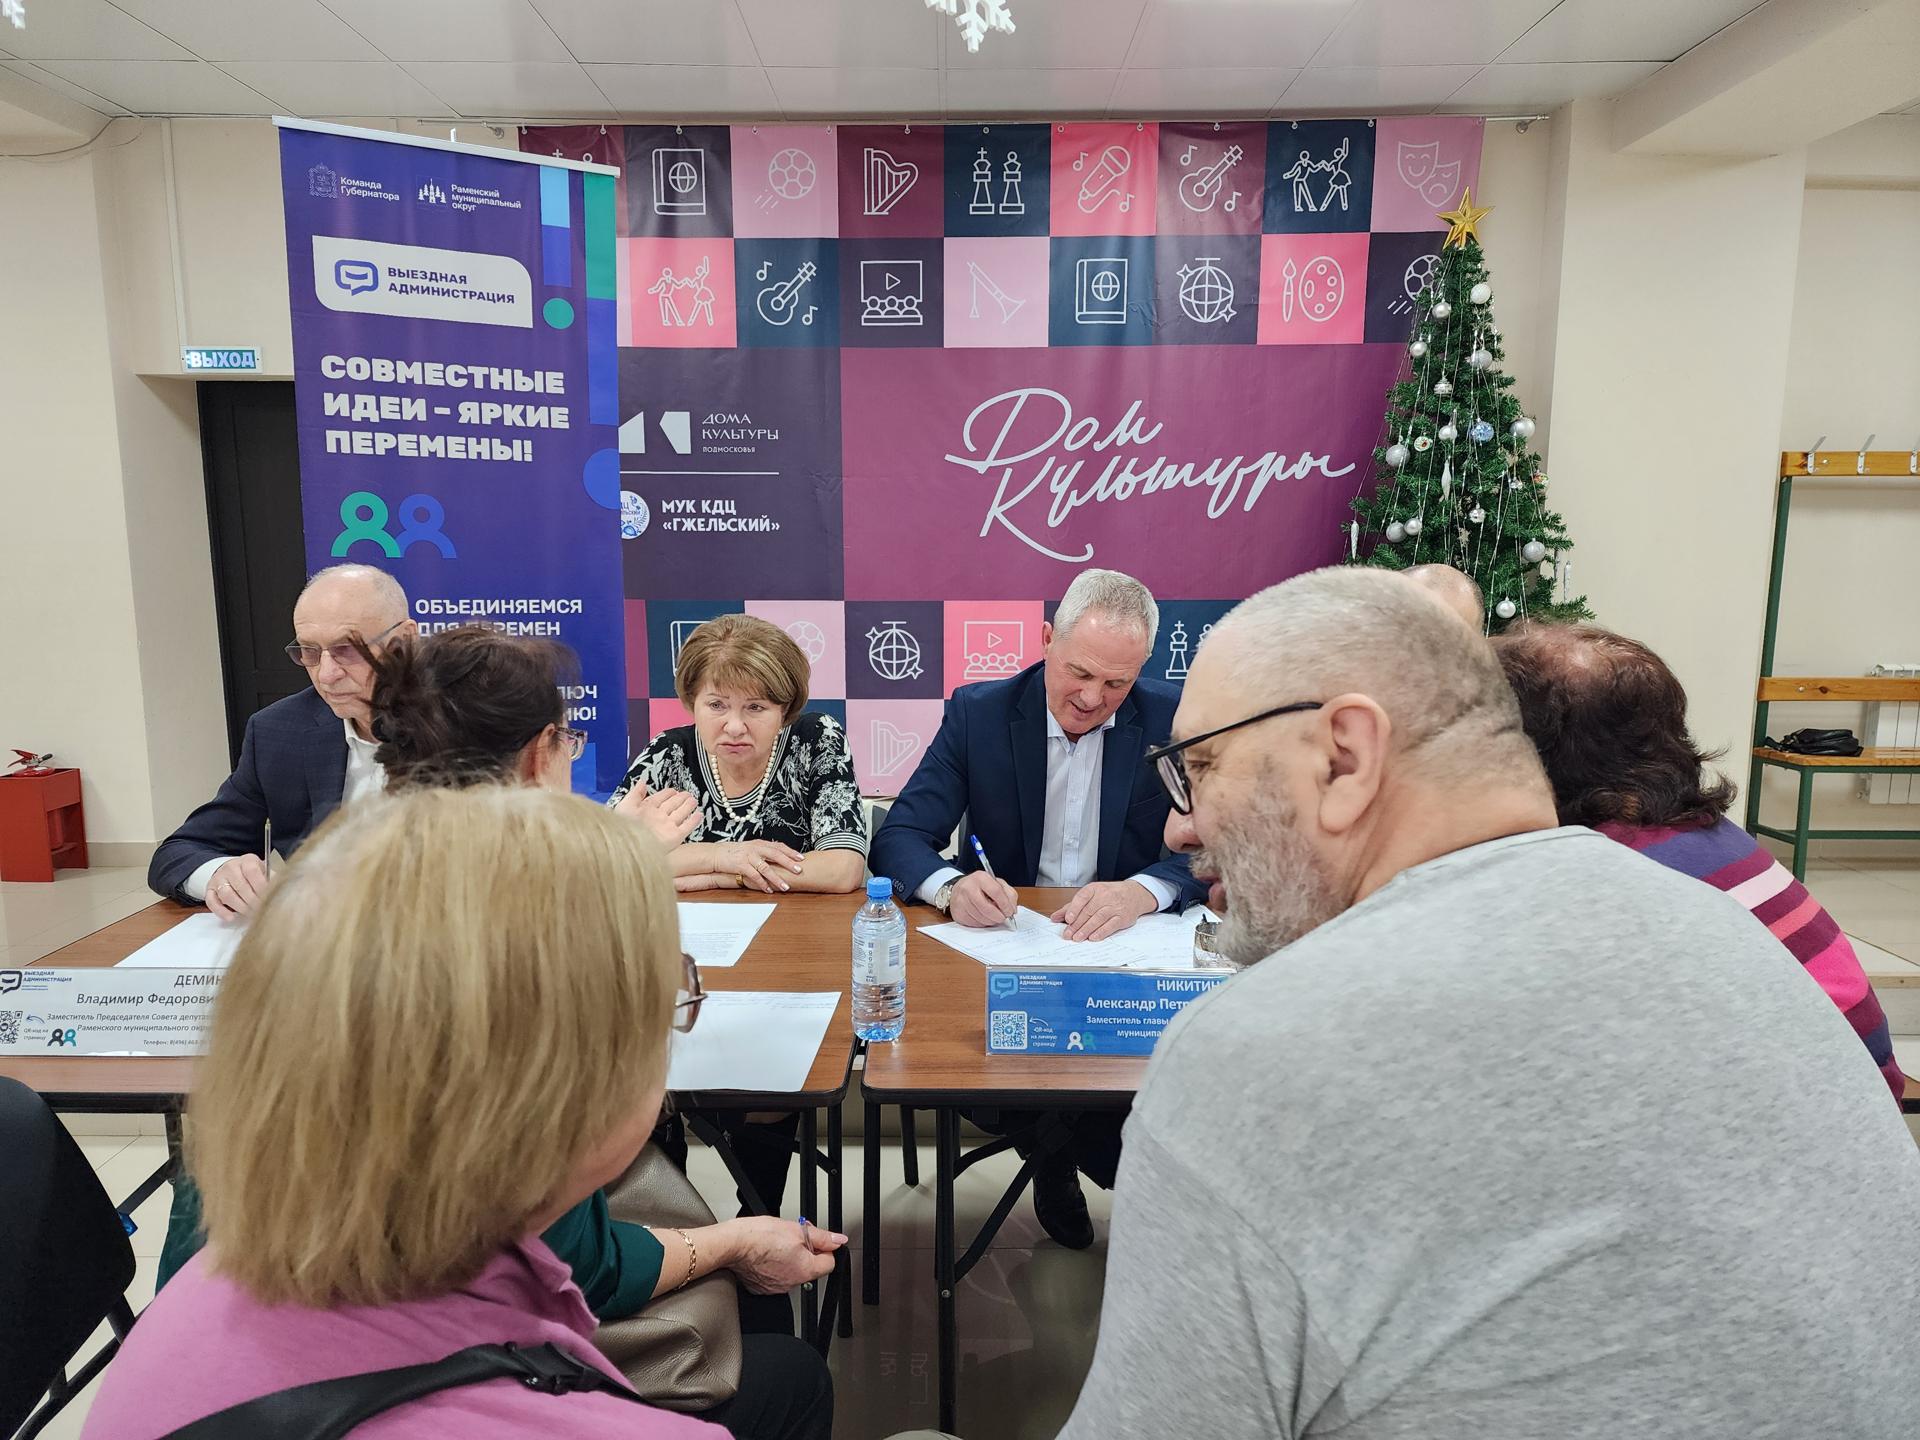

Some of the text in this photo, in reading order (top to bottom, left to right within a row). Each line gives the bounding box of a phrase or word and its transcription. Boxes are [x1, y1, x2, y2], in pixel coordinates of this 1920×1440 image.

[340, 176, 382, 190] Команда
[451, 183, 500, 198] Раменский
[340, 186, 400, 202] Губернатора
[451, 194, 522, 209] муниципальный
[452, 202, 477, 212] округ
[387, 267, 468, 285] ВЫЕЗДНАЯ
[388, 282, 515, 305] АДМИНИСТРАЦИЯ
[190, 351, 255, 368] ВЫХОД
[320, 355, 565, 394] СОВМЕСТНЫЕ
[323, 392, 427, 423] ИДЕИ
[458, 401, 570, 429] ЯРКИЕ
[702, 413, 751, 424] ДОМА
[702, 428, 779, 440] КУЛЬТУРЫ
[944, 387, 1163, 474] Дом
[325, 430, 533, 462] ПЕРЕМЕНЫ!
[661, 499, 736, 515] МУК КДЦ
[979, 451, 1356, 562] Культуры
[663, 515, 780, 532] «ГЖЕЛЬСКИЙ»
[415, 599, 582, 616] ОБЪЕДИНЯЕМСЯ
[77, 993, 215, 1006] Владимир Федорови
[1086, 997, 1157, 1011] Александр
[47, 1013, 94, 1021] Заместитель
[96, 1013, 150, 1021] Председателя
[1086, 1016, 1141, 1025] Заместитель
[77, 1024, 122, 1032] Раменского
